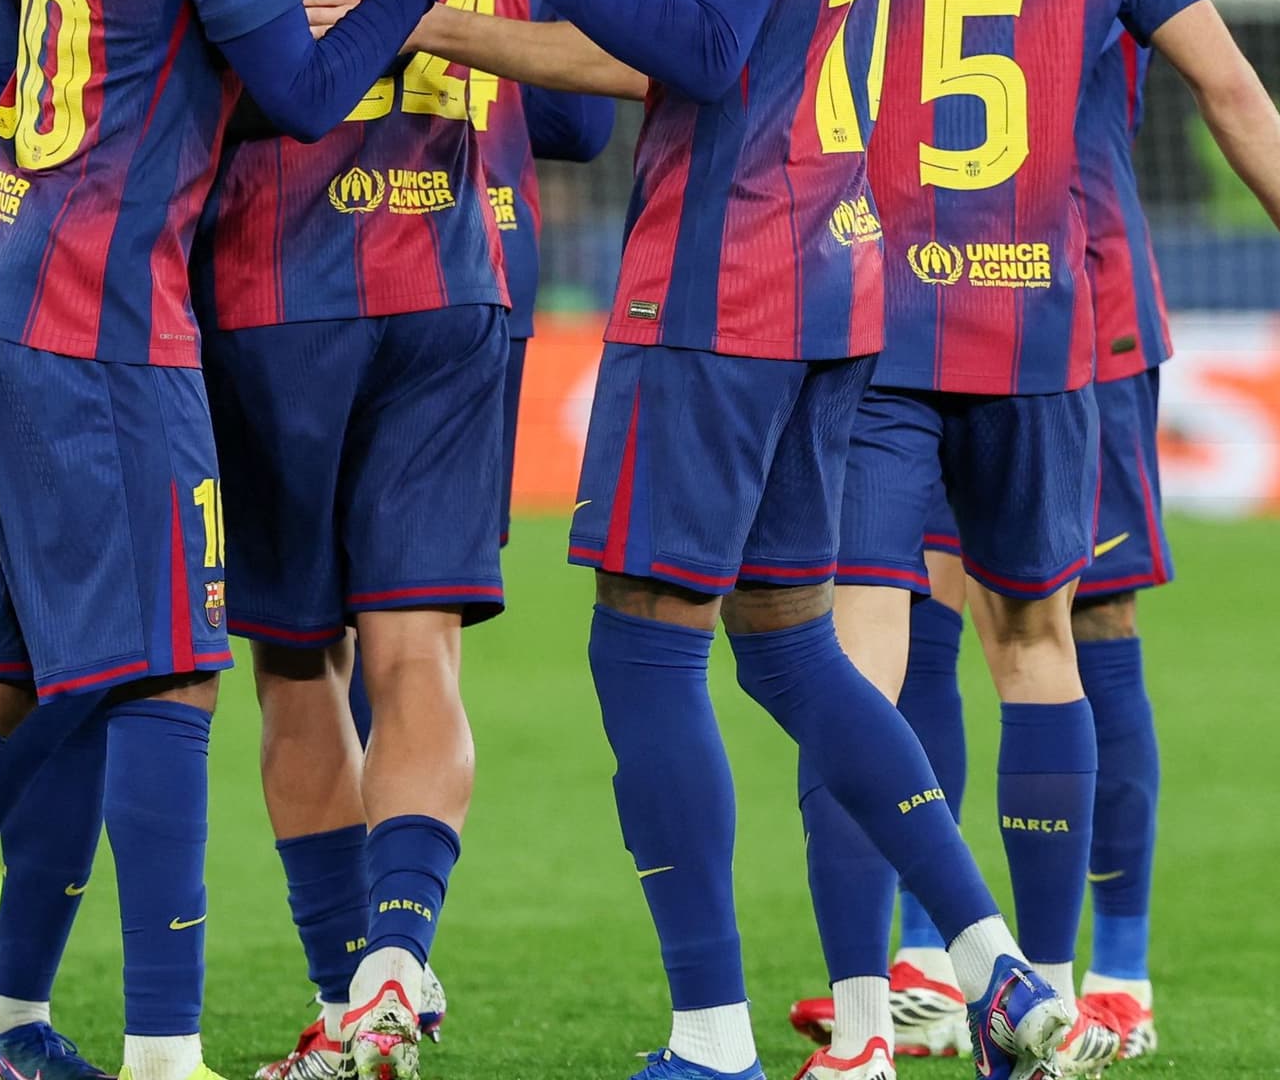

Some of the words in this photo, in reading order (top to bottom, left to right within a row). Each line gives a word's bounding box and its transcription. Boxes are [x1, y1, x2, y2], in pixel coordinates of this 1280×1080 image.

[966, 243, 1050, 261] UNHCR
[968, 261, 1051, 280] ACNUR
[1002, 815, 1069, 833] BARÇA
